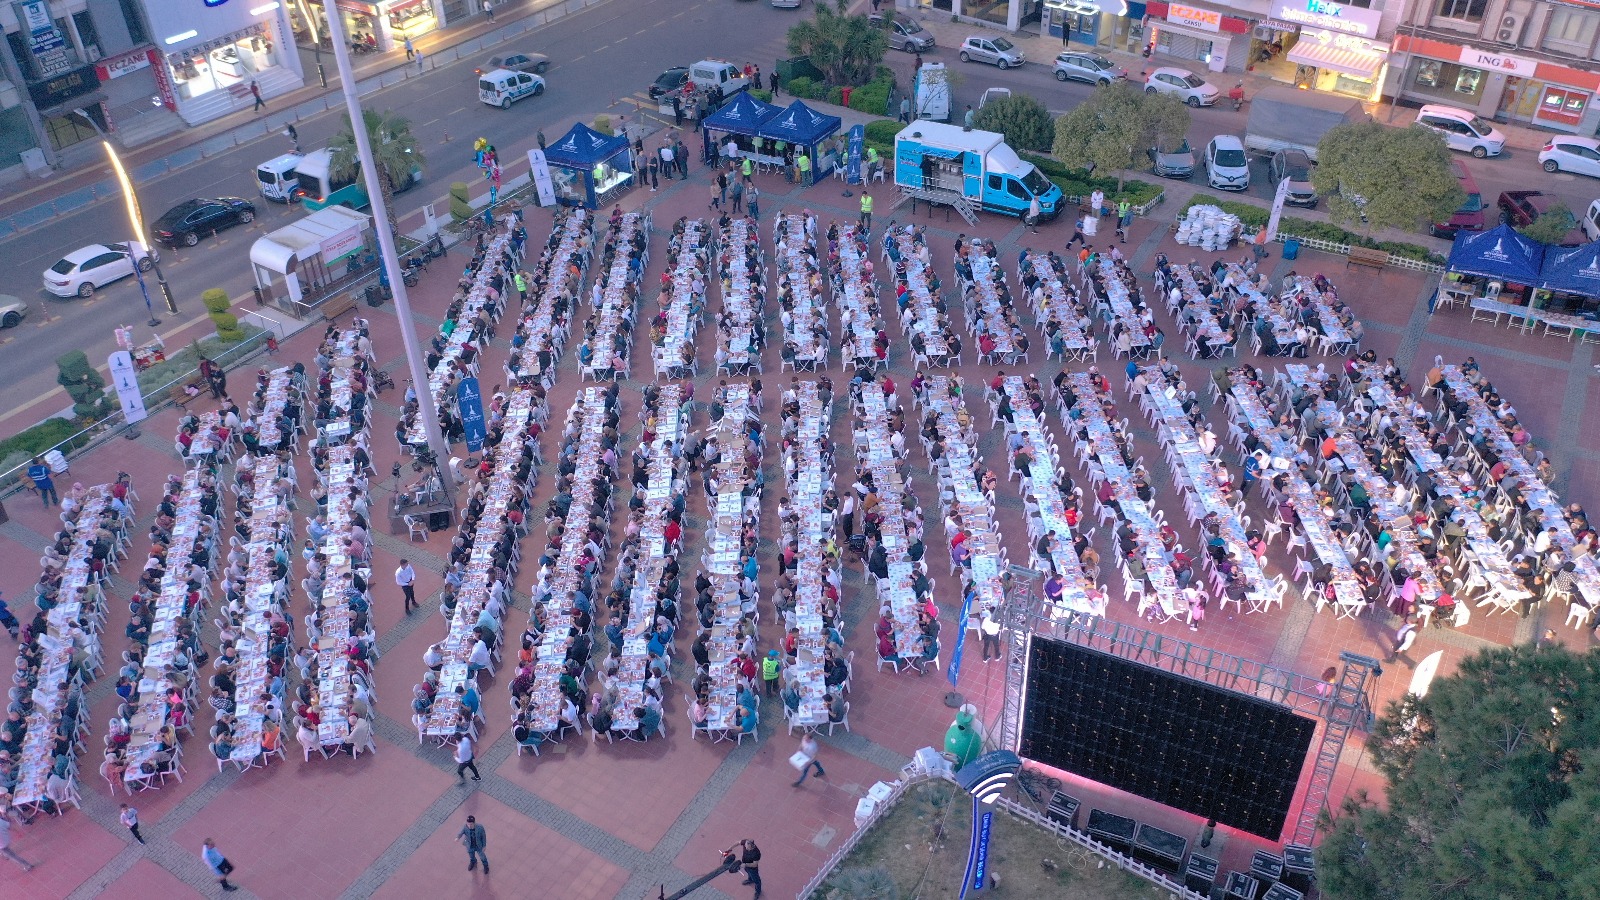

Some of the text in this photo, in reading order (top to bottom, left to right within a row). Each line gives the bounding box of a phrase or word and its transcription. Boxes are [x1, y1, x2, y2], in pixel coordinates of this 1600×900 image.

[1171, 5, 1219, 25] ECZANE
[1307, 0, 1341, 17] Helix
[1183, 19, 1202, 27] CANSU
[108, 53, 146, 72] ECZANE
[1477, 55, 1500, 67] ING
